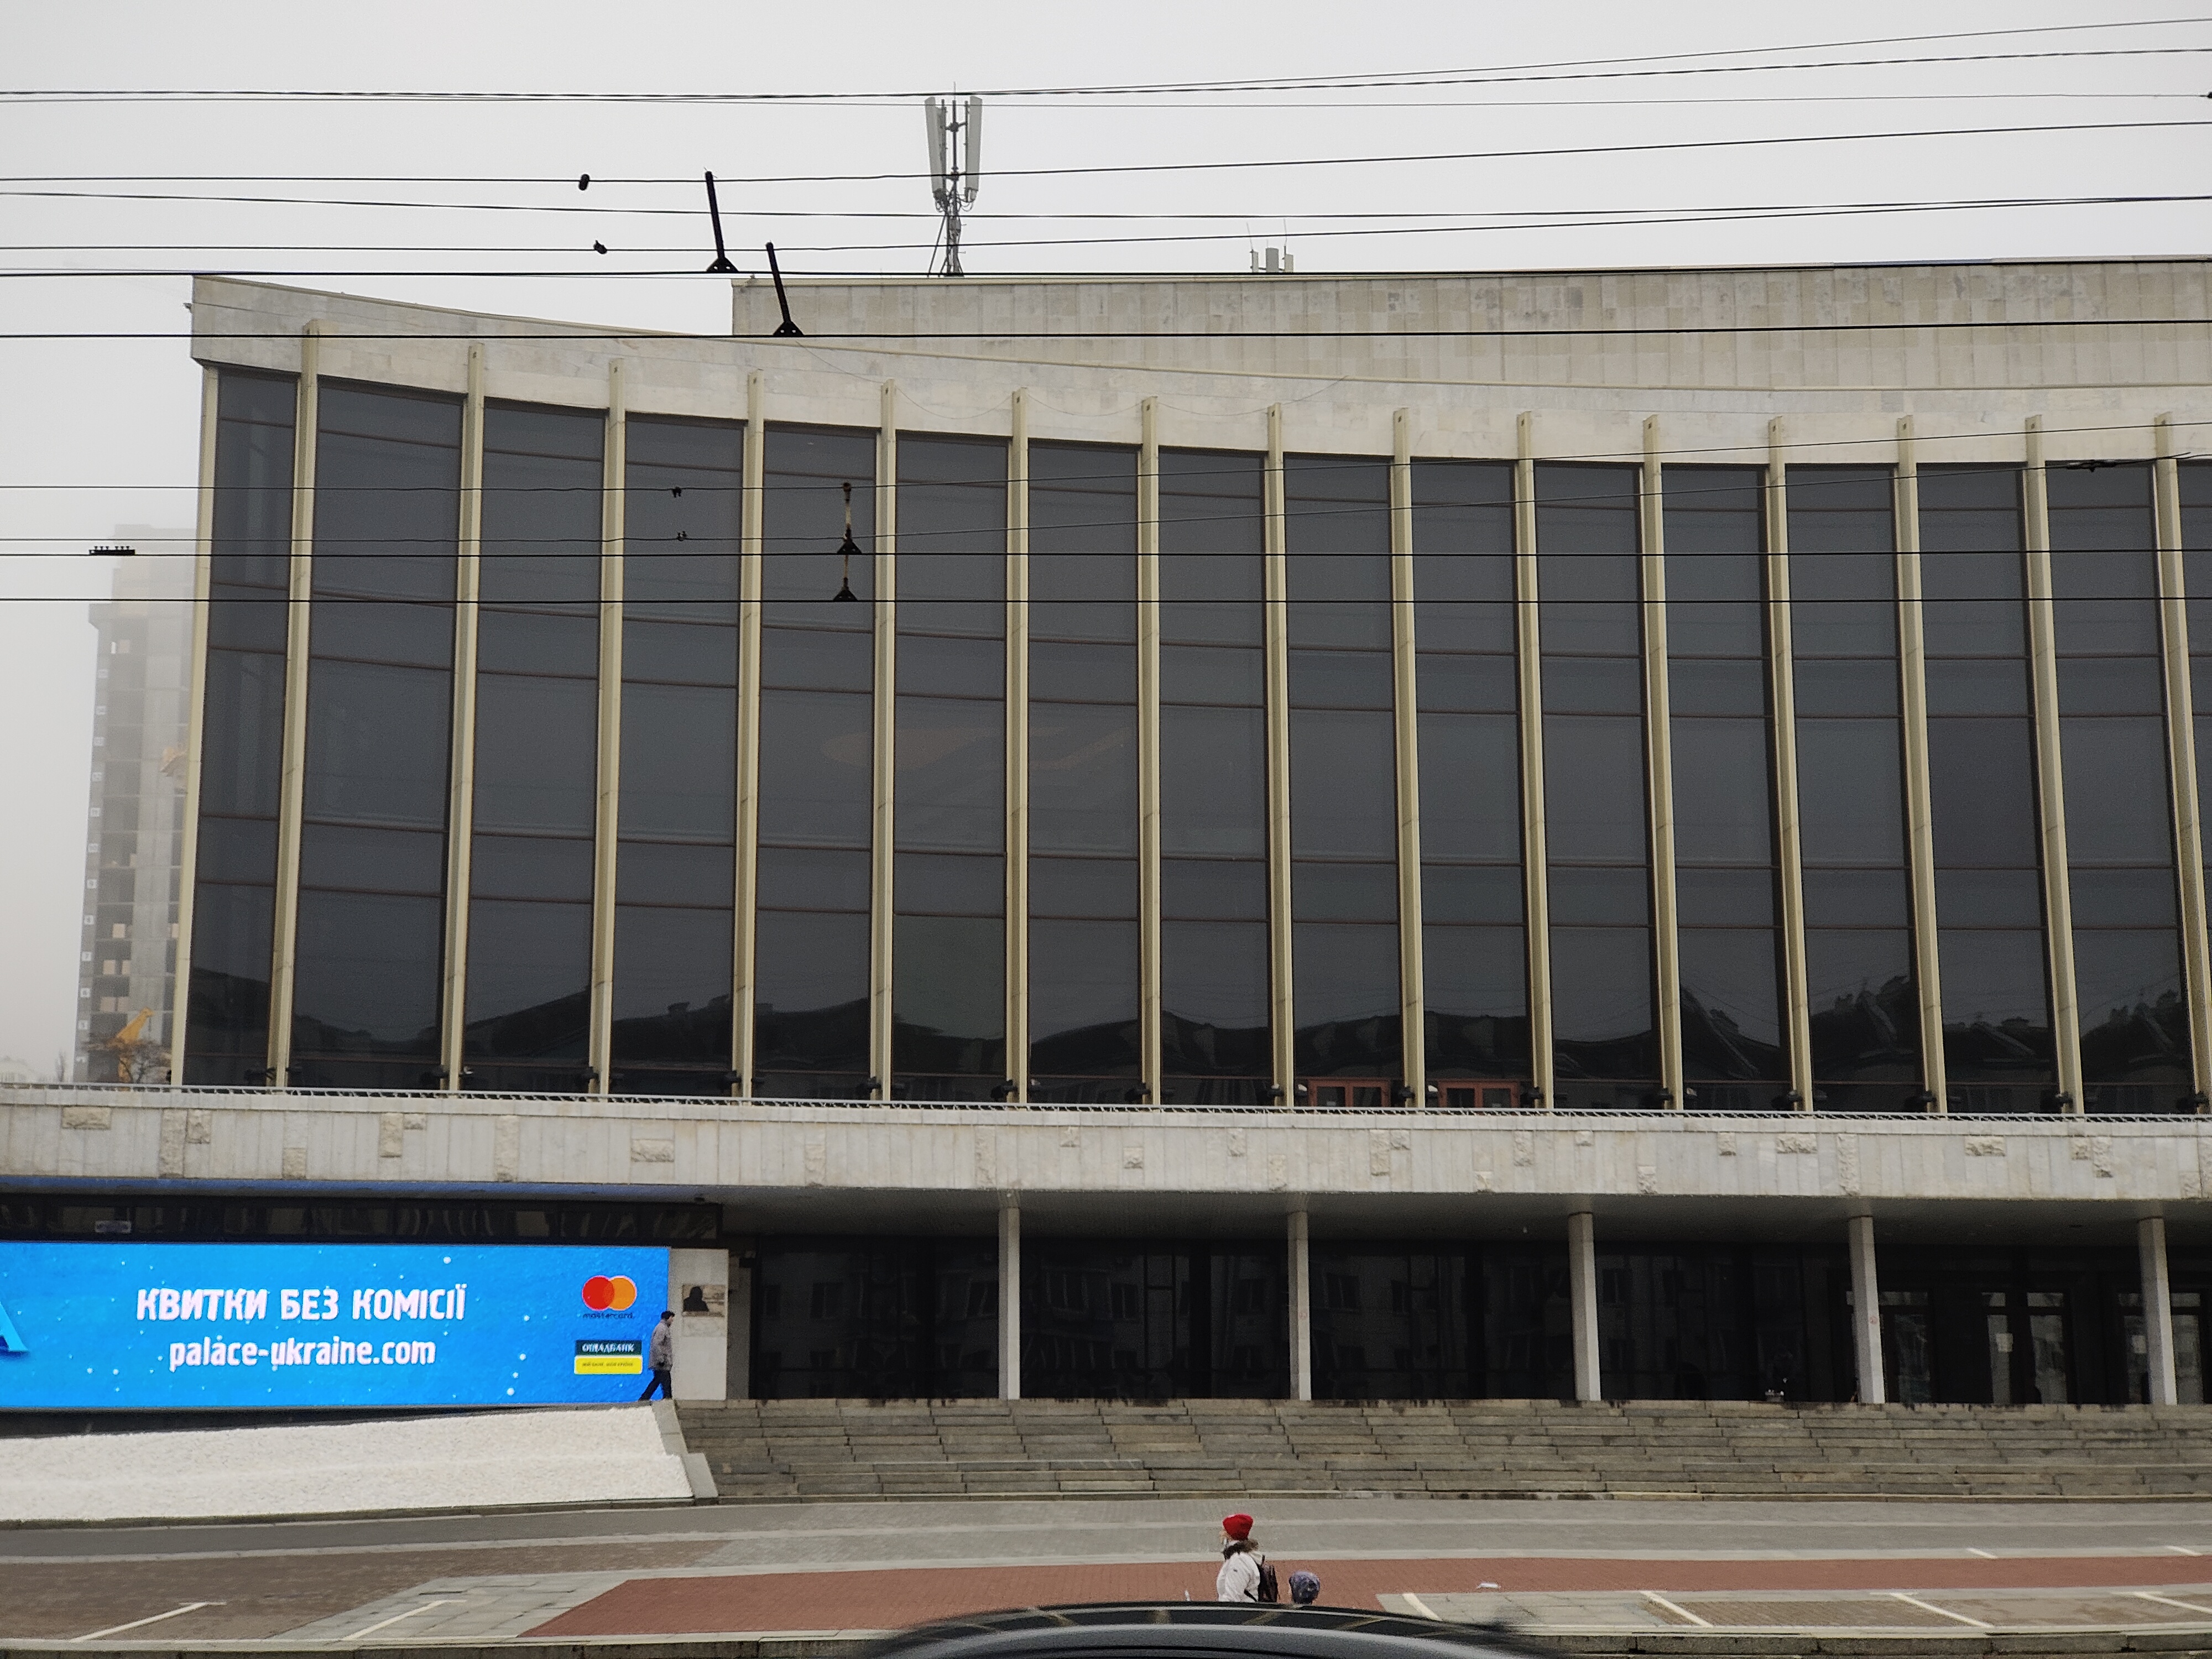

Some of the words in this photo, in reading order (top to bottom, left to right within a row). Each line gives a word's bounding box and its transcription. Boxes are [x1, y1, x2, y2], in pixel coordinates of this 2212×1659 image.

[137, 1288, 268, 1321] КВИТКИ
[280, 1289, 339, 1321] БЕЗ
[352, 1284, 467, 1321] КОМІСІЇ
[169, 1335, 436, 1373] palace-ukraine.com
